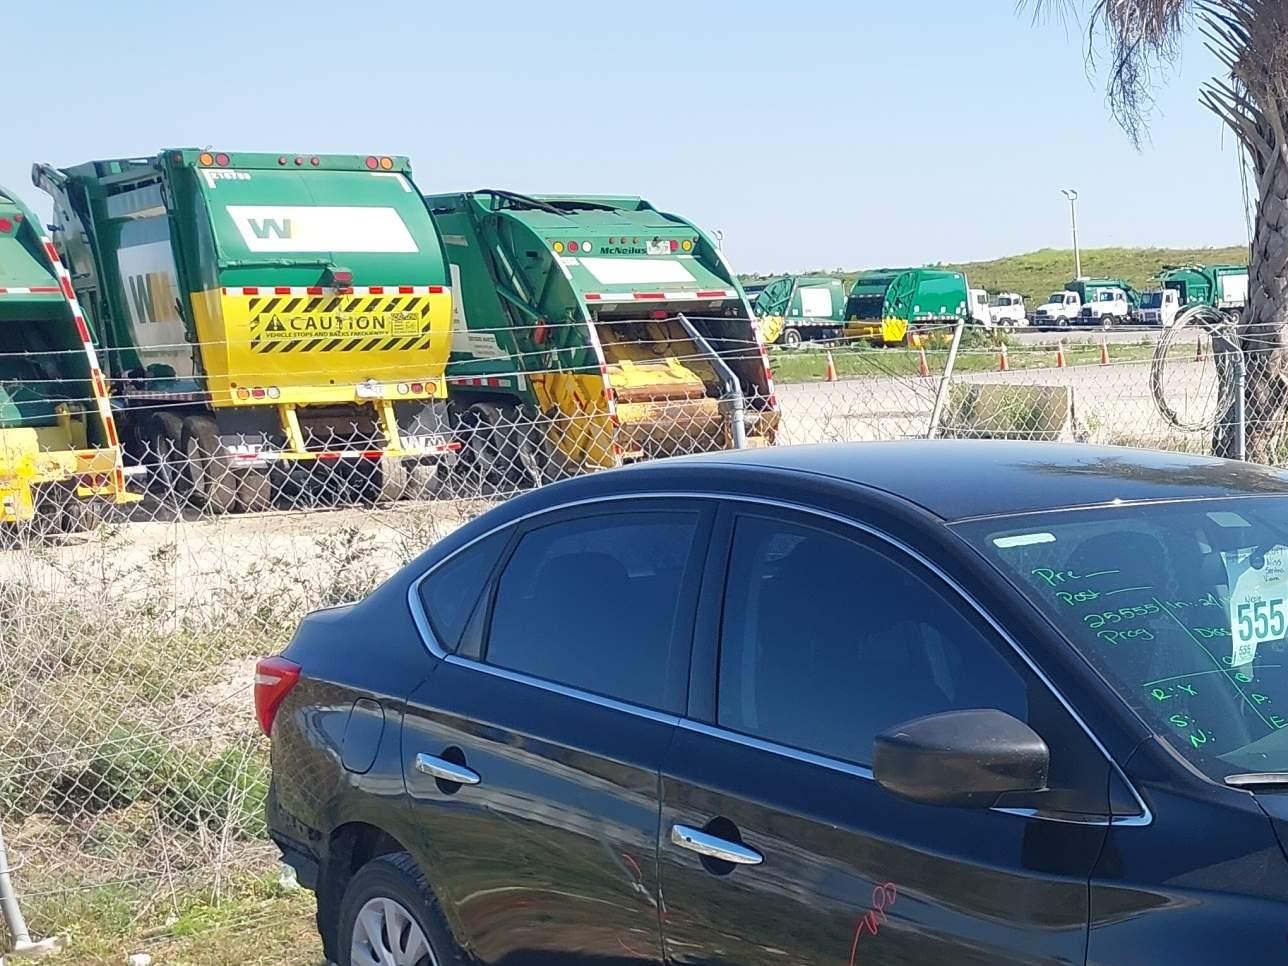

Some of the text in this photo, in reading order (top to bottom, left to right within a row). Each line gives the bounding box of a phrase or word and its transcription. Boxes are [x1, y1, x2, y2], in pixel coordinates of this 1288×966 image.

[600, 247, 647, 255] McNeilus
[290, 315, 385, 331] CAUTION
[1237, 598, 1285, 641] 555
[1239, 645, 1252, 656] 555
